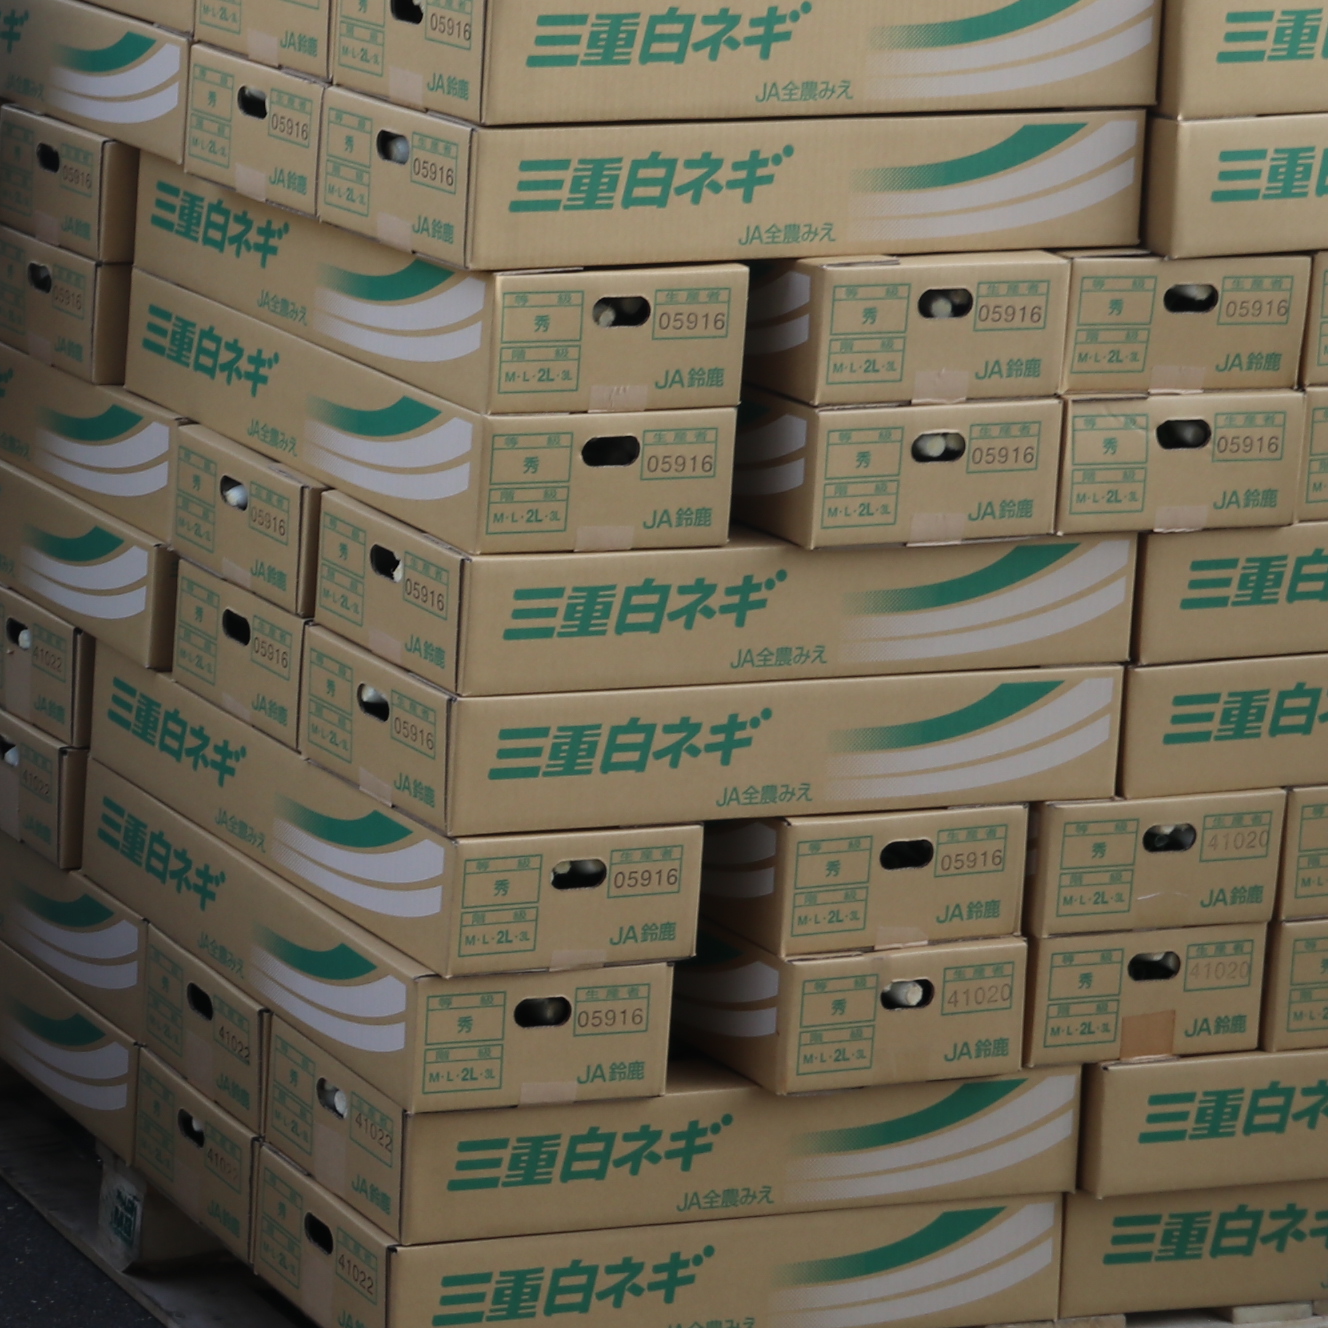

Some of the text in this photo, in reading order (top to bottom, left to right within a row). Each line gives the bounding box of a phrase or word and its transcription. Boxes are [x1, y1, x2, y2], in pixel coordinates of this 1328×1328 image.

[431, 13, 472, 41] 05916
[527, 2, 812, 67] 三重白ネギ
[756, 80, 853, 103] JA全農みえ
[269, 114, 309, 142] 05916
[411, 158, 453, 189] 05916
[510, 146, 794, 212] 三重白ネギ
[151, 179, 289, 267] 三重白ネギ
[739, 223, 835, 246] JA全農みえ
[659, 312, 725, 330] 05916
[978, 305, 1041, 323] 05916
[1226, 298, 1290, 320] 05916
[143, 303, 279, 396] 三重白ネギ
[975, 358, 1041, 380] JA鈴鹿
[1216, 352, 1282, 372] JA鈴鹿
[655, 368, 724, 389] JA鈴鹿
[972, 446, 1034, 464] 05916
[1217, 436, 1278, 453] 05916
[647, 455, 713, 472] 05916
[969, 499, 1033, 521] JA鈴鹿
[1214, 489, 1278, 509] JA鈴鹿
[249, 504, 285, 539] 05916
[643, 508, 712, 529] JA鈴鹿
[404, 578, 444, 613] 05916
[504, 570, 786, 640] 三重白ネギ
[251, 634, 288, 671] 05916
[730, 645, 826, 669] JA全農みえ
[108, 678, 246, 786] 三重白ネギ
[393, 714, 436, 753] 05916
[489, 708, 772, 779] 三重白ネギ
[716, 783, 812, 807] JA全農みえ
[96, 797, 228, 914] 三重白ネギ
[941, 847, 1005, 873] 05916
[614, 868, 677, 888] 05916
[936, 900, 1000, 924] JA鈴鹿
[610, 922, 676, 945] JA鈴鹿
[578, 1008, 643, 1028] 05916
[577, 1061, 645, 1084] JA鈴鹿
[448, 1115, 732, 1191] 三重白ネギ
[677, 1186, 773, 1212] JA全農みえ
[433, 1246, 717, 1328] 三重白ネギ
